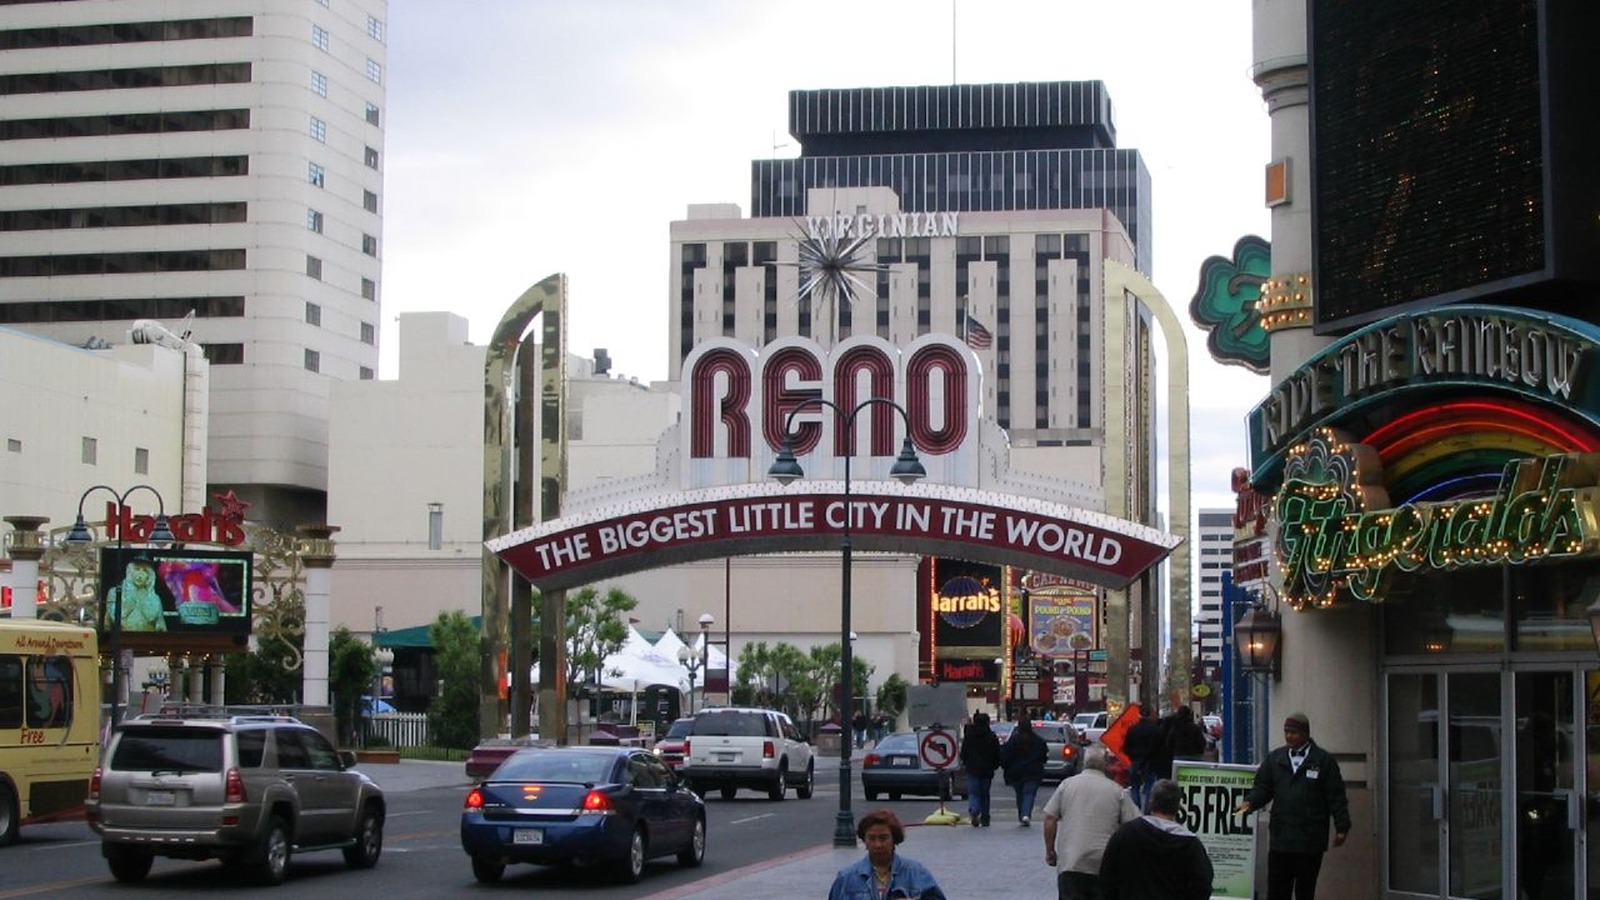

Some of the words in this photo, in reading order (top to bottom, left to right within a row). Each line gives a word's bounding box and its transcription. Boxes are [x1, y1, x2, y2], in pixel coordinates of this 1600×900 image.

[806, 211, 960, 240] VIRGINIAN
[691, 343, 968, 458] RENO
[1261, 359, 1334, 452] RIDE
[1335, 326, 1407, 397] THE
[1410, 316, 1593, 400] RAINBOW
[535, 533, 590, 571] THE
[598, 508, 717, 554] BIGGEST
[729, 502, 815, 533] LITTLE
[825, 502, 889, 529] CITY
[896, 503, 930, 531] IN
[941, 506, 997, 539] THE
[1005, 516, 1122, 566] WORLD
[20, 727, 45, 744] Free
